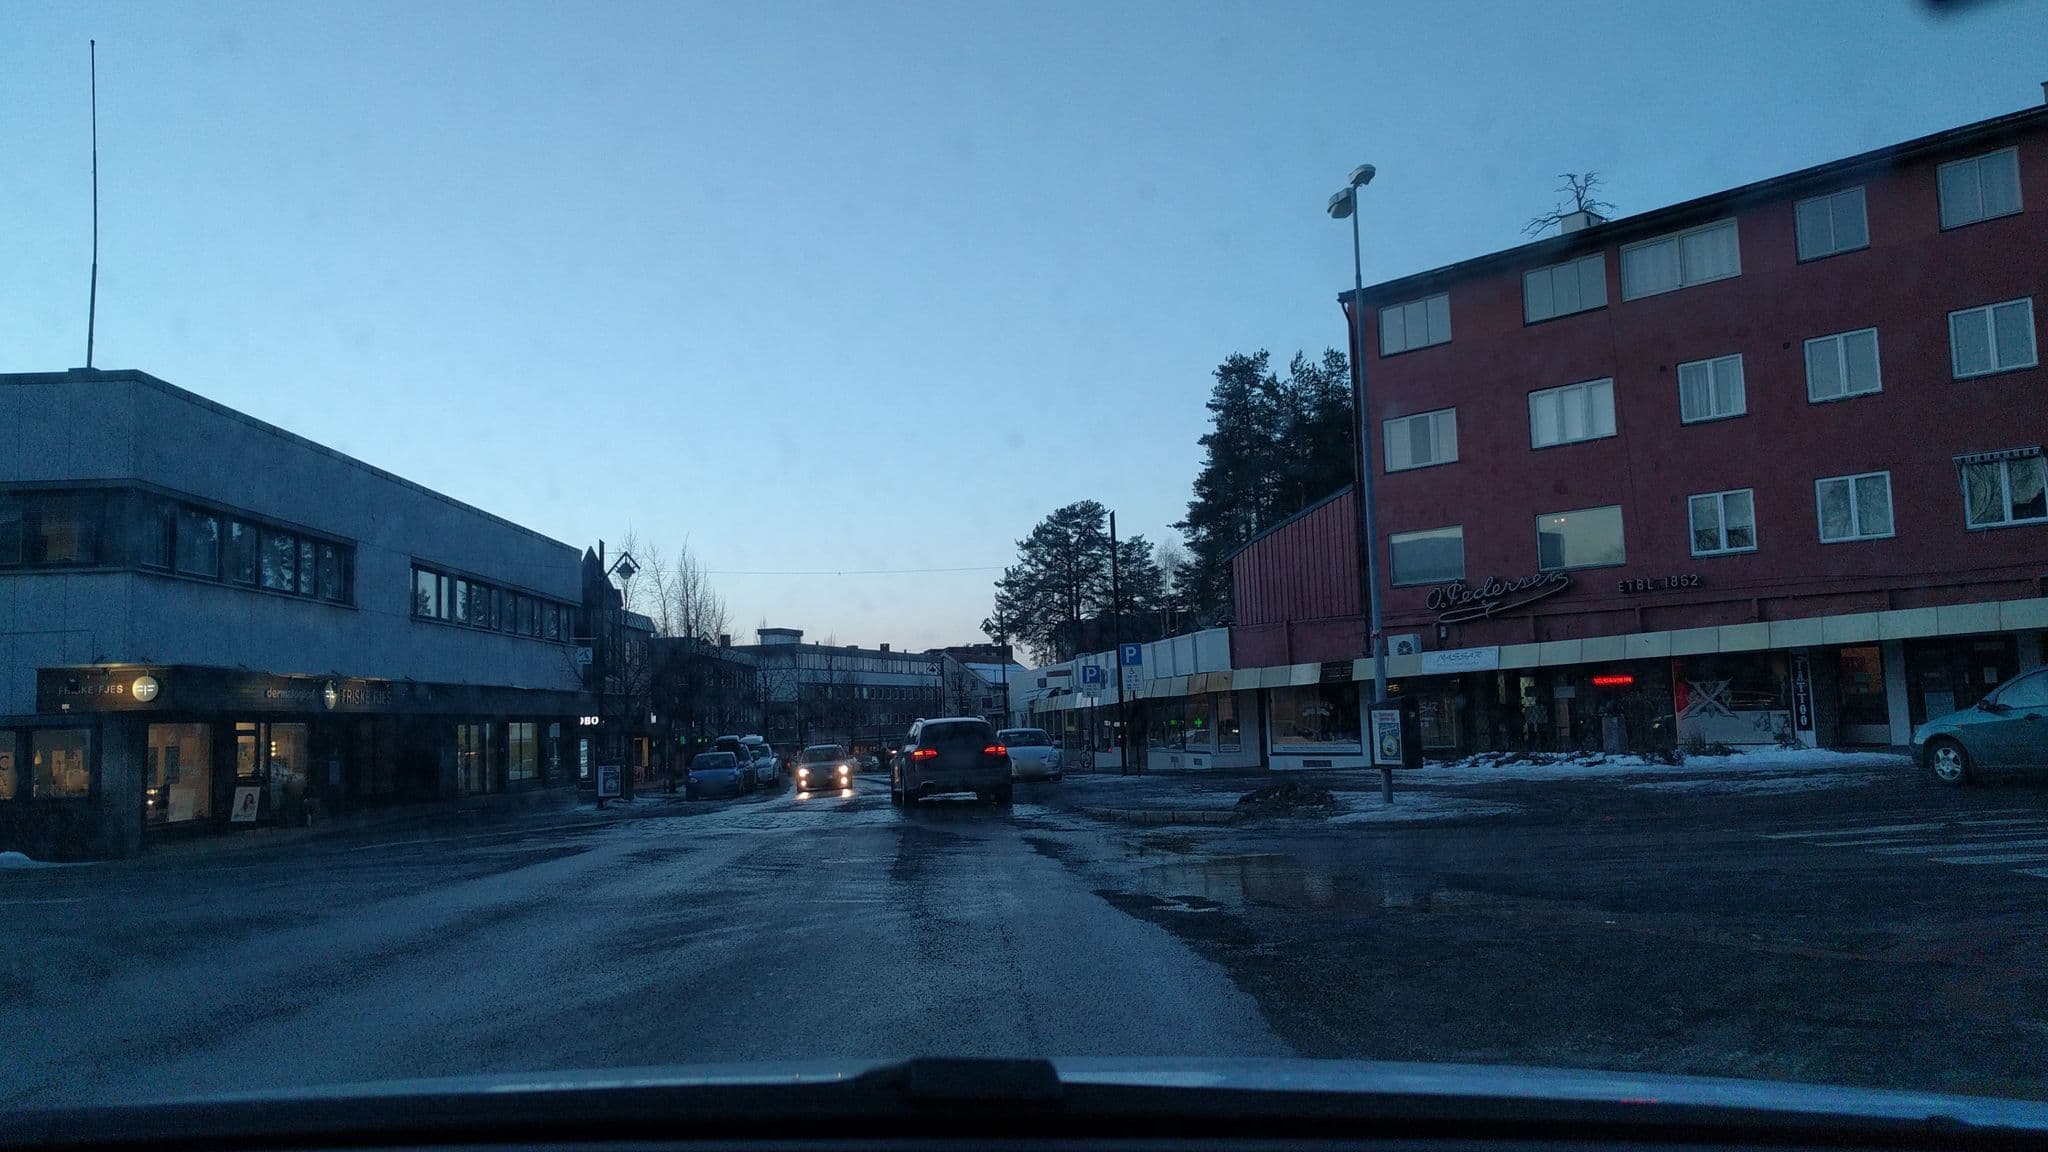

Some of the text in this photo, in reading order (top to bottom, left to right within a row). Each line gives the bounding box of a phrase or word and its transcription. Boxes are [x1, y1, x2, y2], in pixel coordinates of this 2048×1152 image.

[1664, 574, 1698, 588] 1862
[1125, 646, 1137, 664] P
[1086, 667, 1097, 682] P
